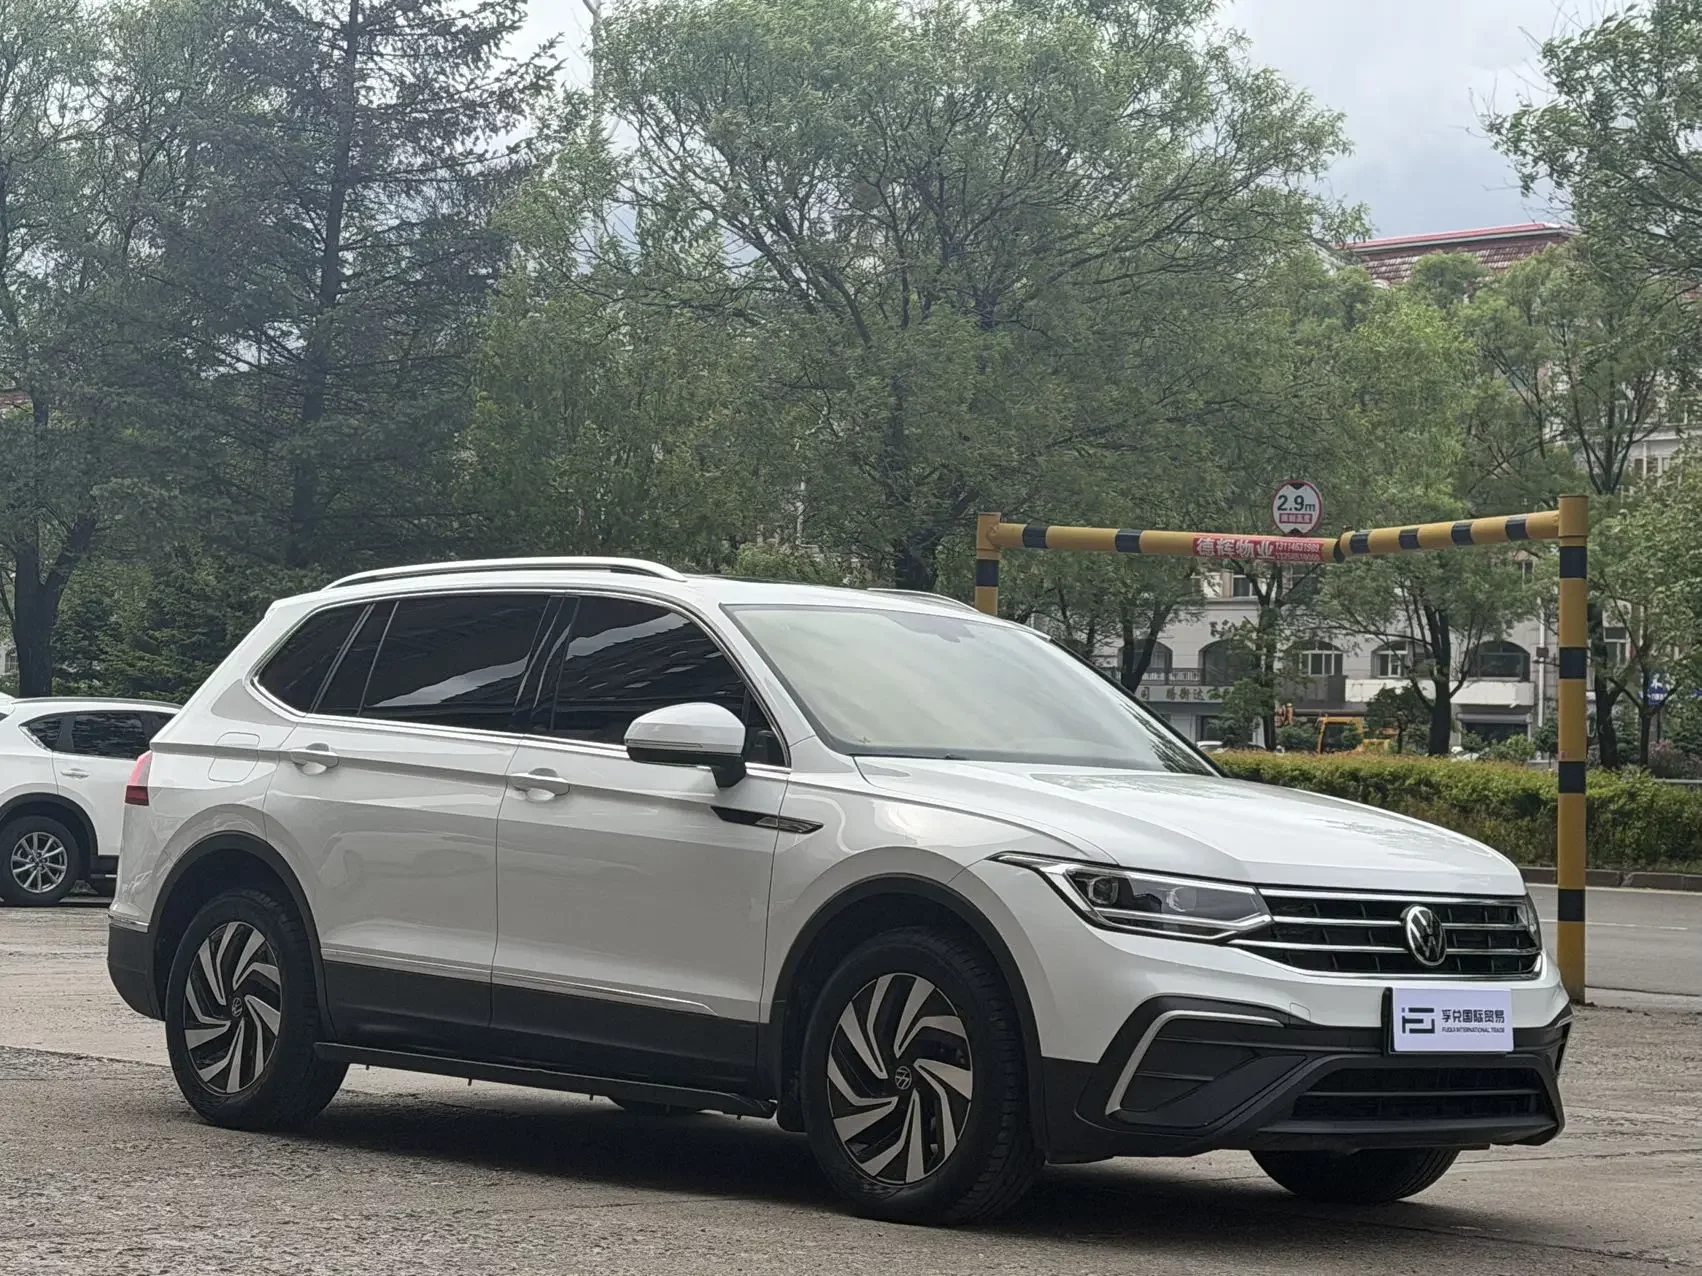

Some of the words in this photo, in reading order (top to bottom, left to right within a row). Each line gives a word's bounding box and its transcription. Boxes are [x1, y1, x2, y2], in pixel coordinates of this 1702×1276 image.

[1277, 494, 1316, 512] 2.9m
[1196, 538, 1275, 559] 德辉物业
[1441, 1009, 1505, 1023] 孚兑国际贸易
[1491, 1026, 1505, 1034] TRADE
